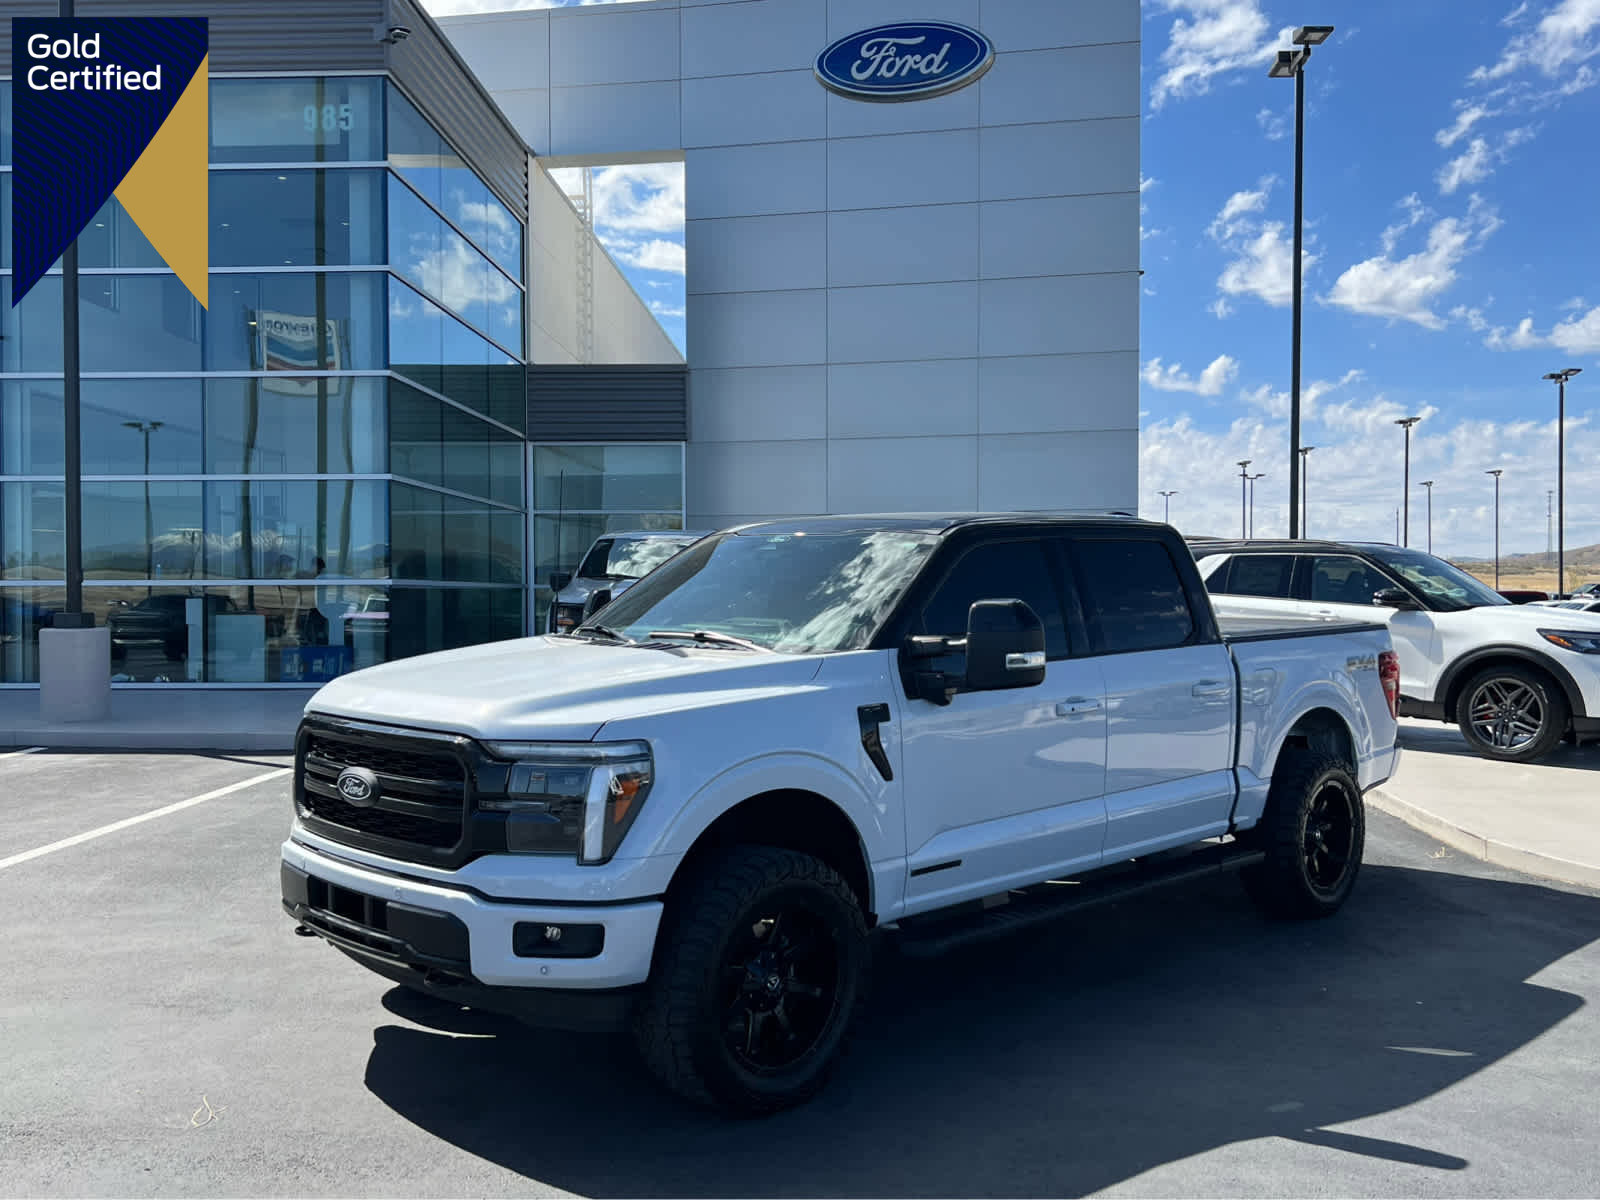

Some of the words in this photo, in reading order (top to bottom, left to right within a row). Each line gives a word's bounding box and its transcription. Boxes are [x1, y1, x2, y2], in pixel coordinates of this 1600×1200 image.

[851, 36, 951, 80] Ford
[303, 104, 353, 132] 985
[343, 777, 365, 796] Ford
